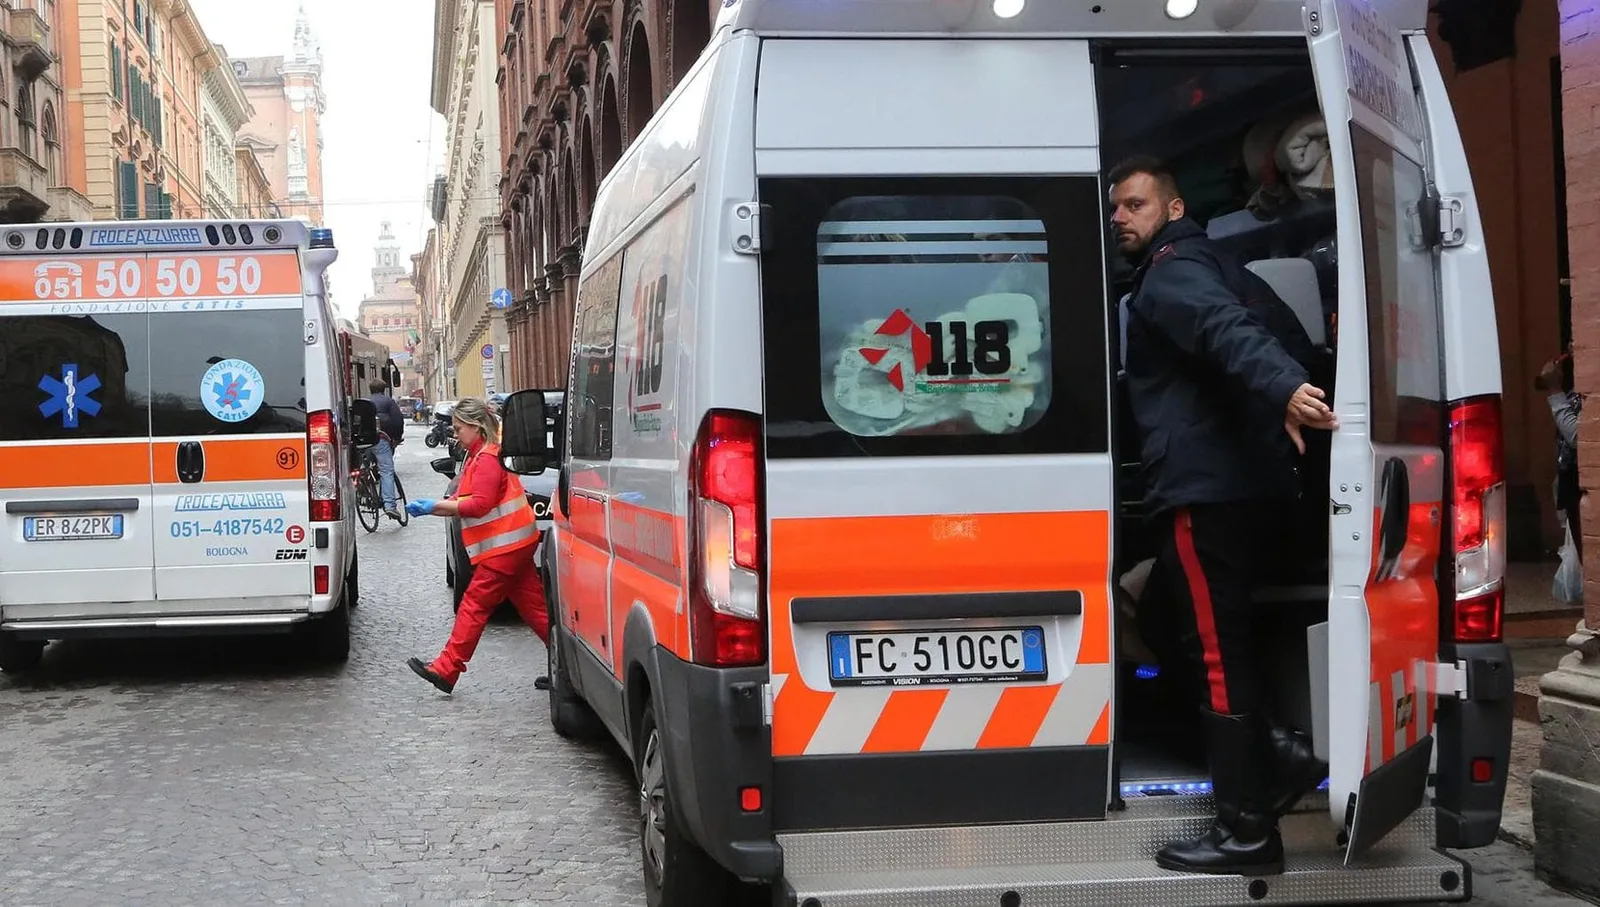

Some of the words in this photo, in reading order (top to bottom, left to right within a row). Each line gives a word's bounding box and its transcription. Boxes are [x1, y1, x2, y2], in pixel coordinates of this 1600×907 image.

[34, 277, 83, 298] 051
[96, 260, 141, 298] 50
[156, 258, 201, 296] 50
[216, 257, 262, 294] 50
[50, 302, 170, 314] FONDAZIONE
[181, 300, 244, 310] CATIS
[925, 320, 1011, 376] 118
[203, 361, 262, 386] FONDAZIONE
[217, 410, 249, 421] CATIS
[279, 451, 296, 466] 91
[36, 519, 55, 536] ER
[61, 517, 111, 535] 842PK
[170, 518, 285, 538] 051-4187542
[206, 547, 249, 557] BOLOGNA
[275, 549, 307, 560] EDM
[855, 637, 897, 673] FC
[913, 634, 1020, 672] 510GC
[893, 677, 921, 685] VISION
